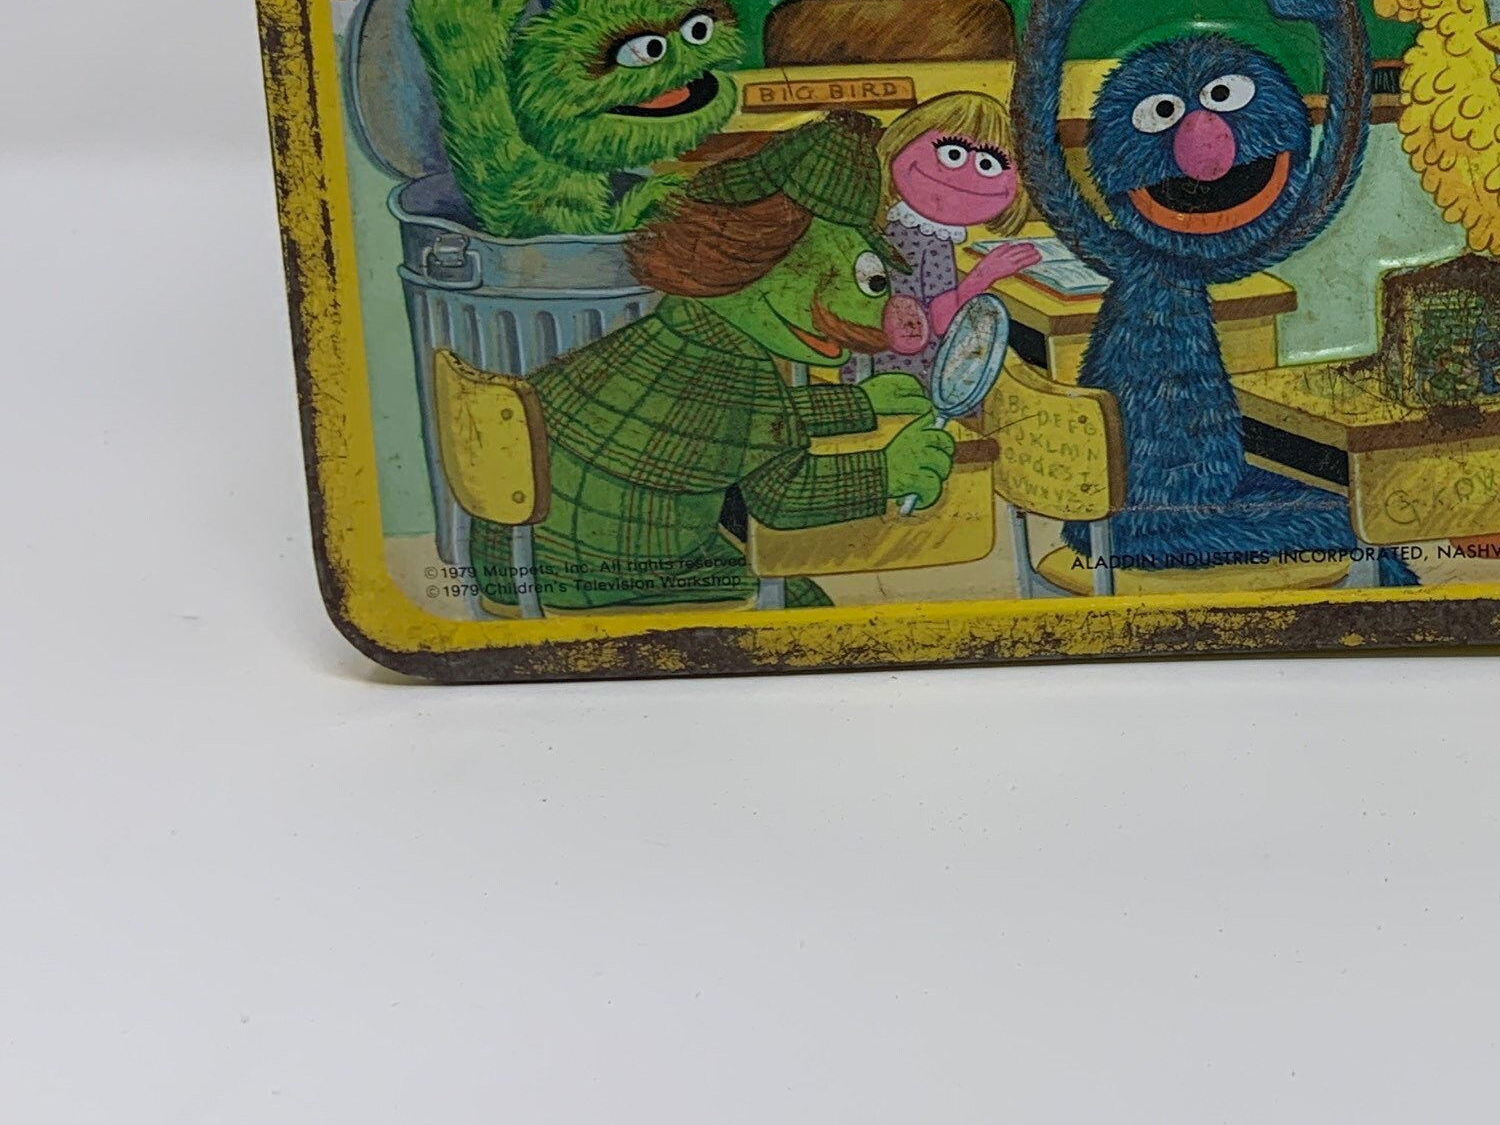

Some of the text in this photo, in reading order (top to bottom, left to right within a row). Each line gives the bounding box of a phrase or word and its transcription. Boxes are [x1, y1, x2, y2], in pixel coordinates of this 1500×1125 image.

[759, 82, 898, 103] BIG BIRD
[483, 562, 559, 578] Muppets,
[564, 561, 594, 574] Inc.
[600, 560, 621, 573] All
[627, 558, 675, 574] rights
[679, 554, 752, 570] reserved.
[1071, 553, 1157, 571] ALADDIN
[1164, 548, 1271, 568] INDUSTRIES
[1278, 544, 1430, 565] INCORPORATED,
[485, 580, 567, 596] Children's
[573, 577, 655, 593] Television
[660, 574, 742, 589] Workshop
